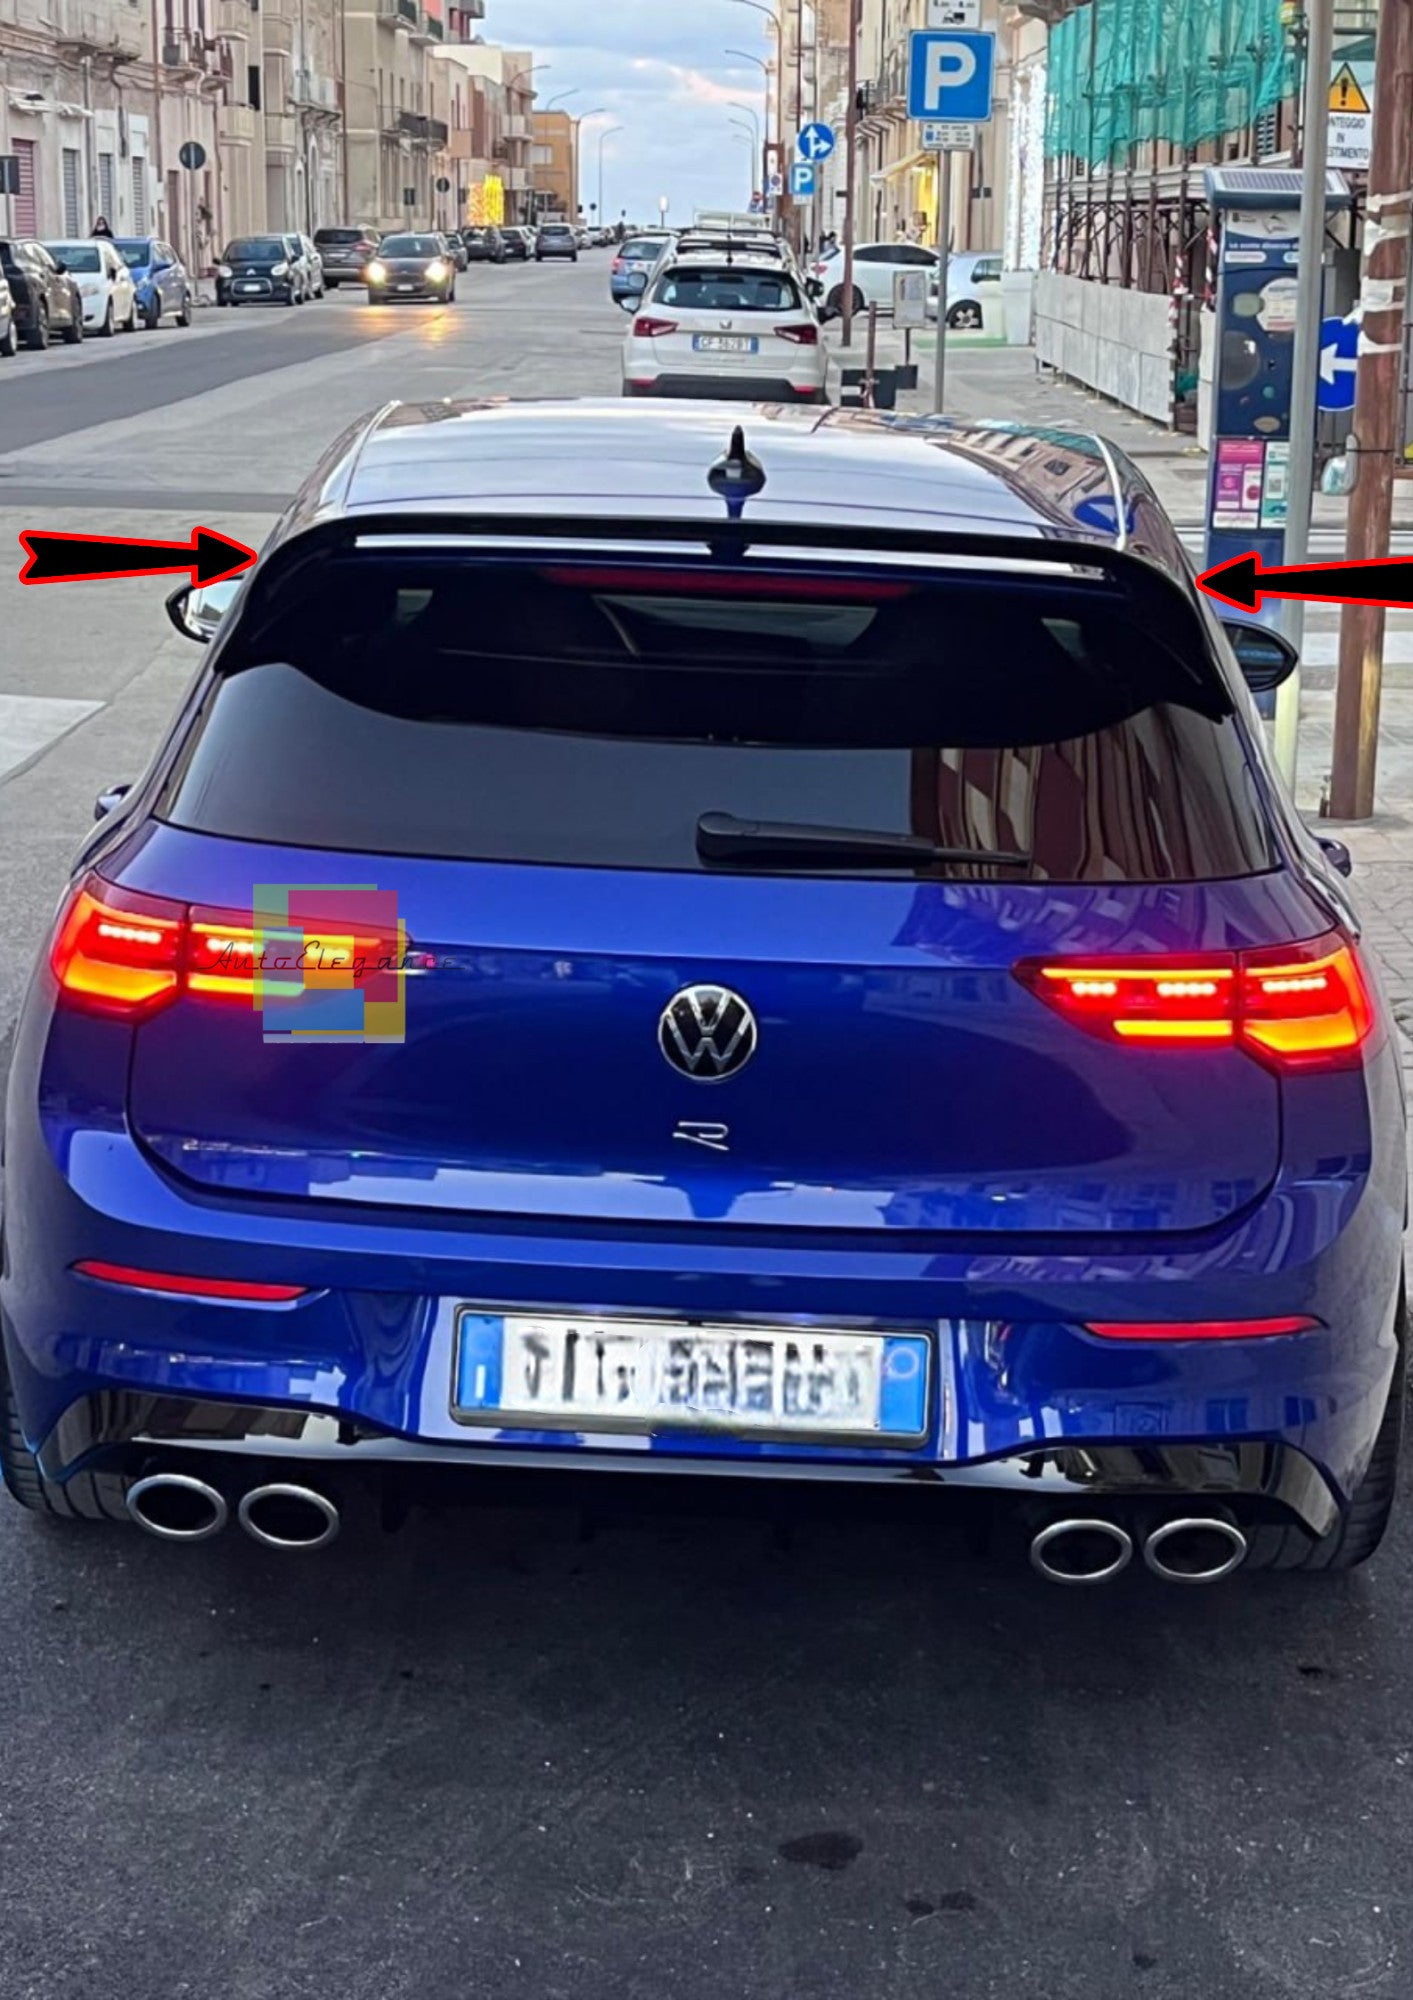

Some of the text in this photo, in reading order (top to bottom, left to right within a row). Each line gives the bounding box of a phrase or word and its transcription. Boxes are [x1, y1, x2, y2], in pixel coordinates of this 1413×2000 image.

[924, 41, 977, 111] P
[794, 168, 813, 192] P
[672, 1121, 730, 1150] R
